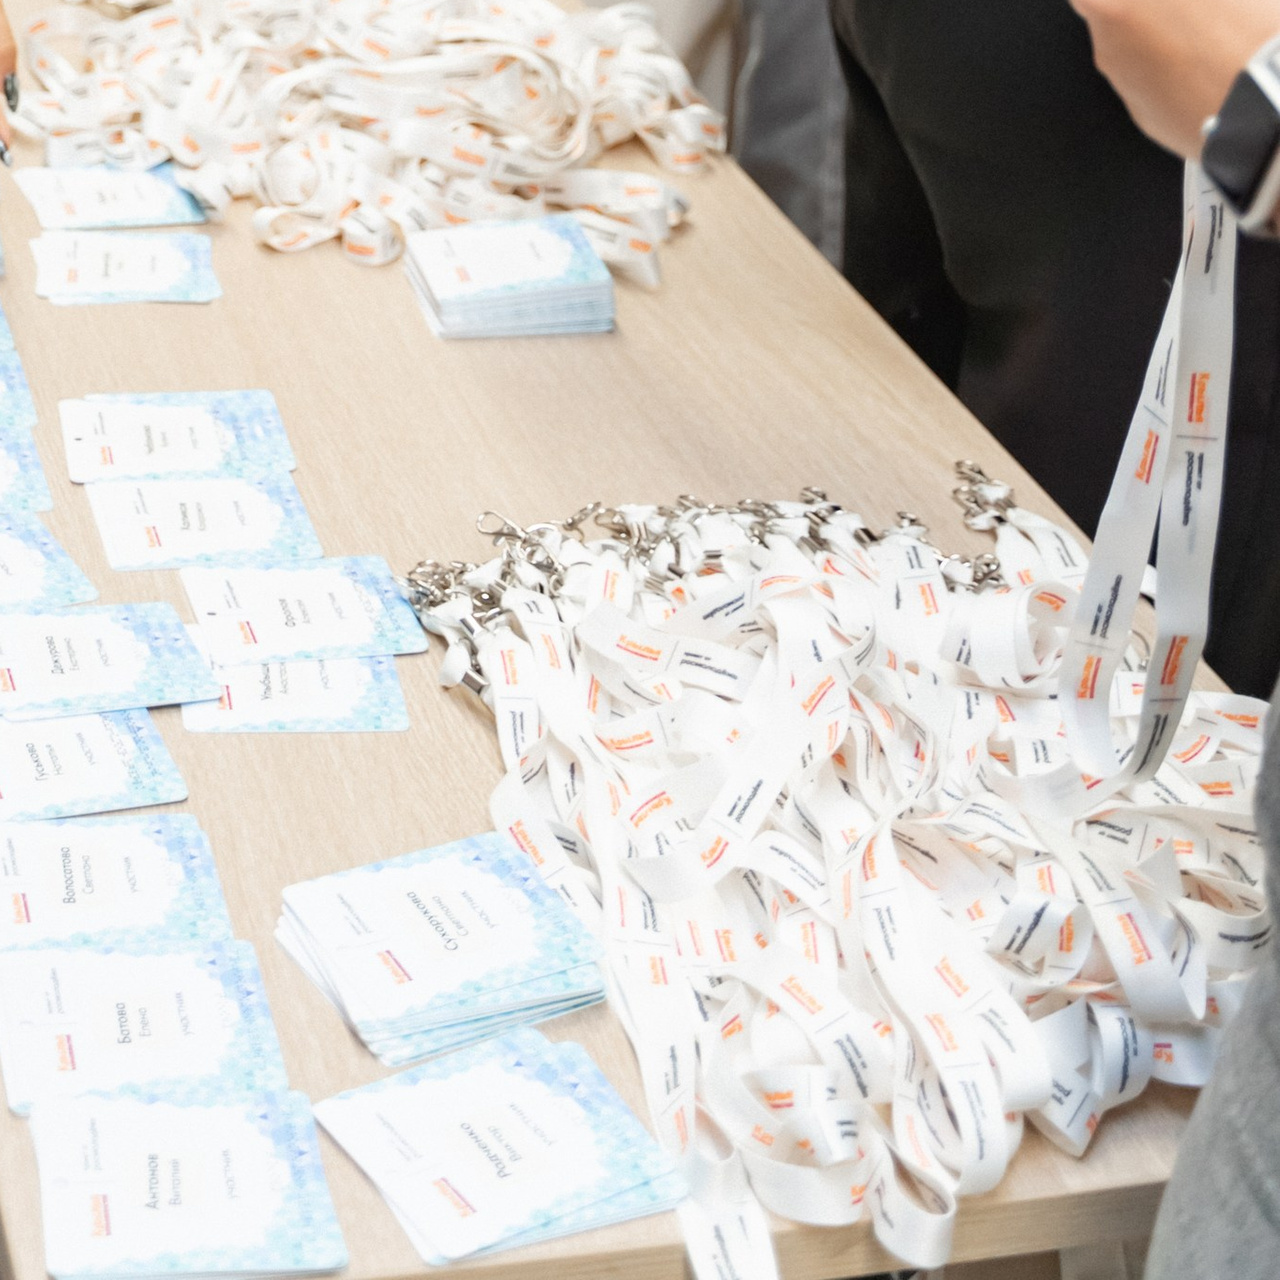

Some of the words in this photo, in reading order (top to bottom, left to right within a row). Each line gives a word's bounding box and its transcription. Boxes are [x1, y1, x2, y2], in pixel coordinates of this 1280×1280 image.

[26, 742, 48, 782] Гуськова
[45, 744, 64, 777] Наталья
[514, 819, 546, 866] Крылья
[61, 846, 76, 904] Волосатова
[82, 854, 95, 896] Светлана
[406, 890, 460, 952] Сухорукова
[431, 895, 469, 938] Светлана
[1117, 913, 1147, 967] Крылья
[117, 1002, 132, 1045] Батова
[139, 1007, 152, 1038] Елена
[460, 1121, 513, 1180] Радченко
[487, 1125, 522, 1163] Виктор
[144, 1153, 160, 1211] Антонов
[168, 1158, 182, 1206] Виталий
